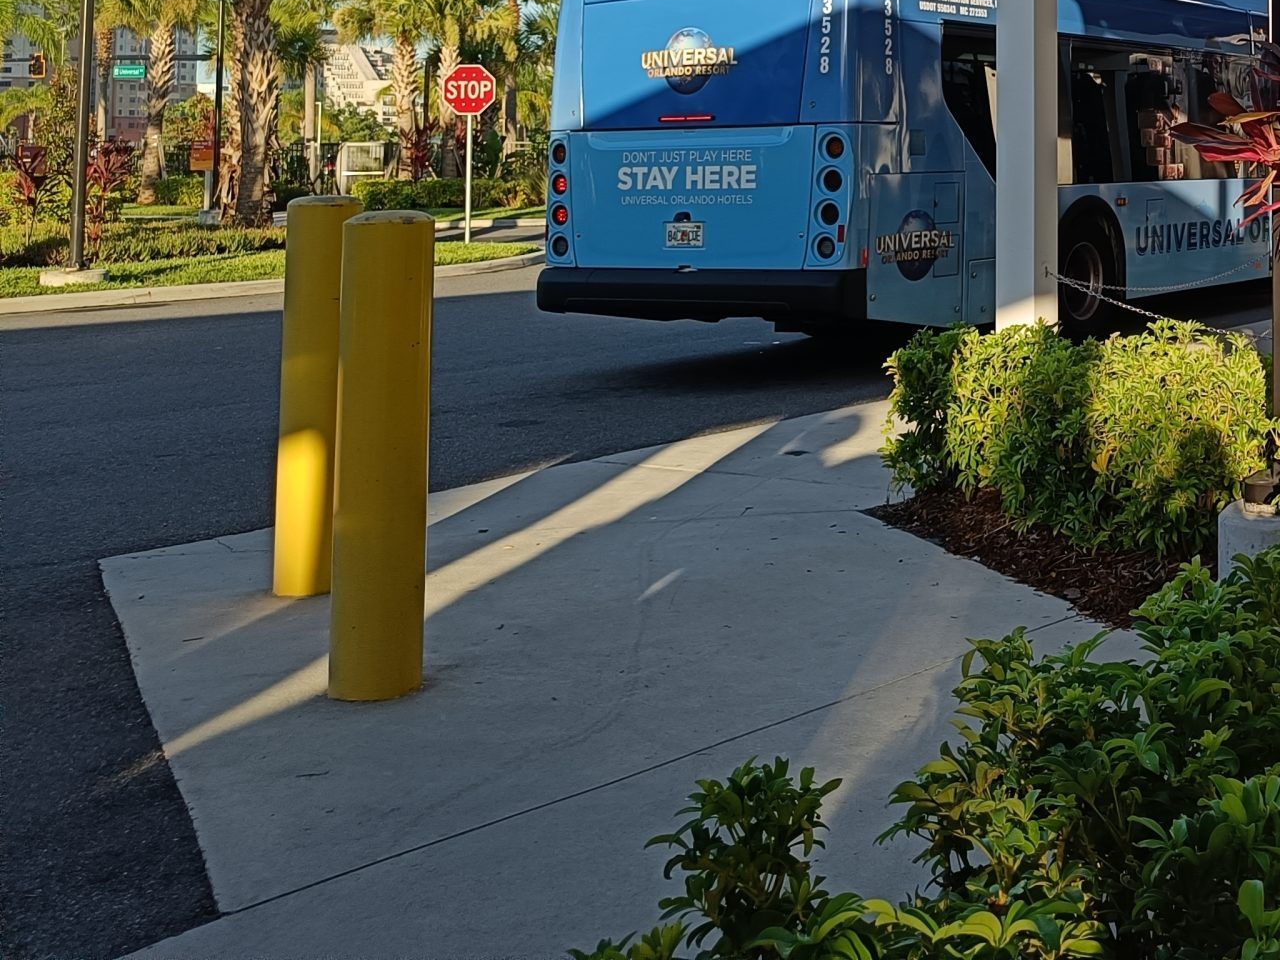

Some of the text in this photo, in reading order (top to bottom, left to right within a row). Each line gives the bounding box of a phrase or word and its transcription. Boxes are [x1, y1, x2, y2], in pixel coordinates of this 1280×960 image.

[919, 0, 936, 12] USDOT
[884, 0, 893, 75] 3528
[642, 47, 738, 69] UNIVERSAL
[647, 65, 730, 78] ORLANDO RESORT
[446, 80, 492, 99] STOP
[622, 149, 752, 164] DON'T JUST PLAY HERE
[617, 165, 757, 190] STAY HERE
[621, 194, 753, 205] UNIVERSAL ORLANDO HOTELS
[876, 230, 955, 254] UNIVERSAL
[1135, 217, 1247, 256] UNIVERSAL
